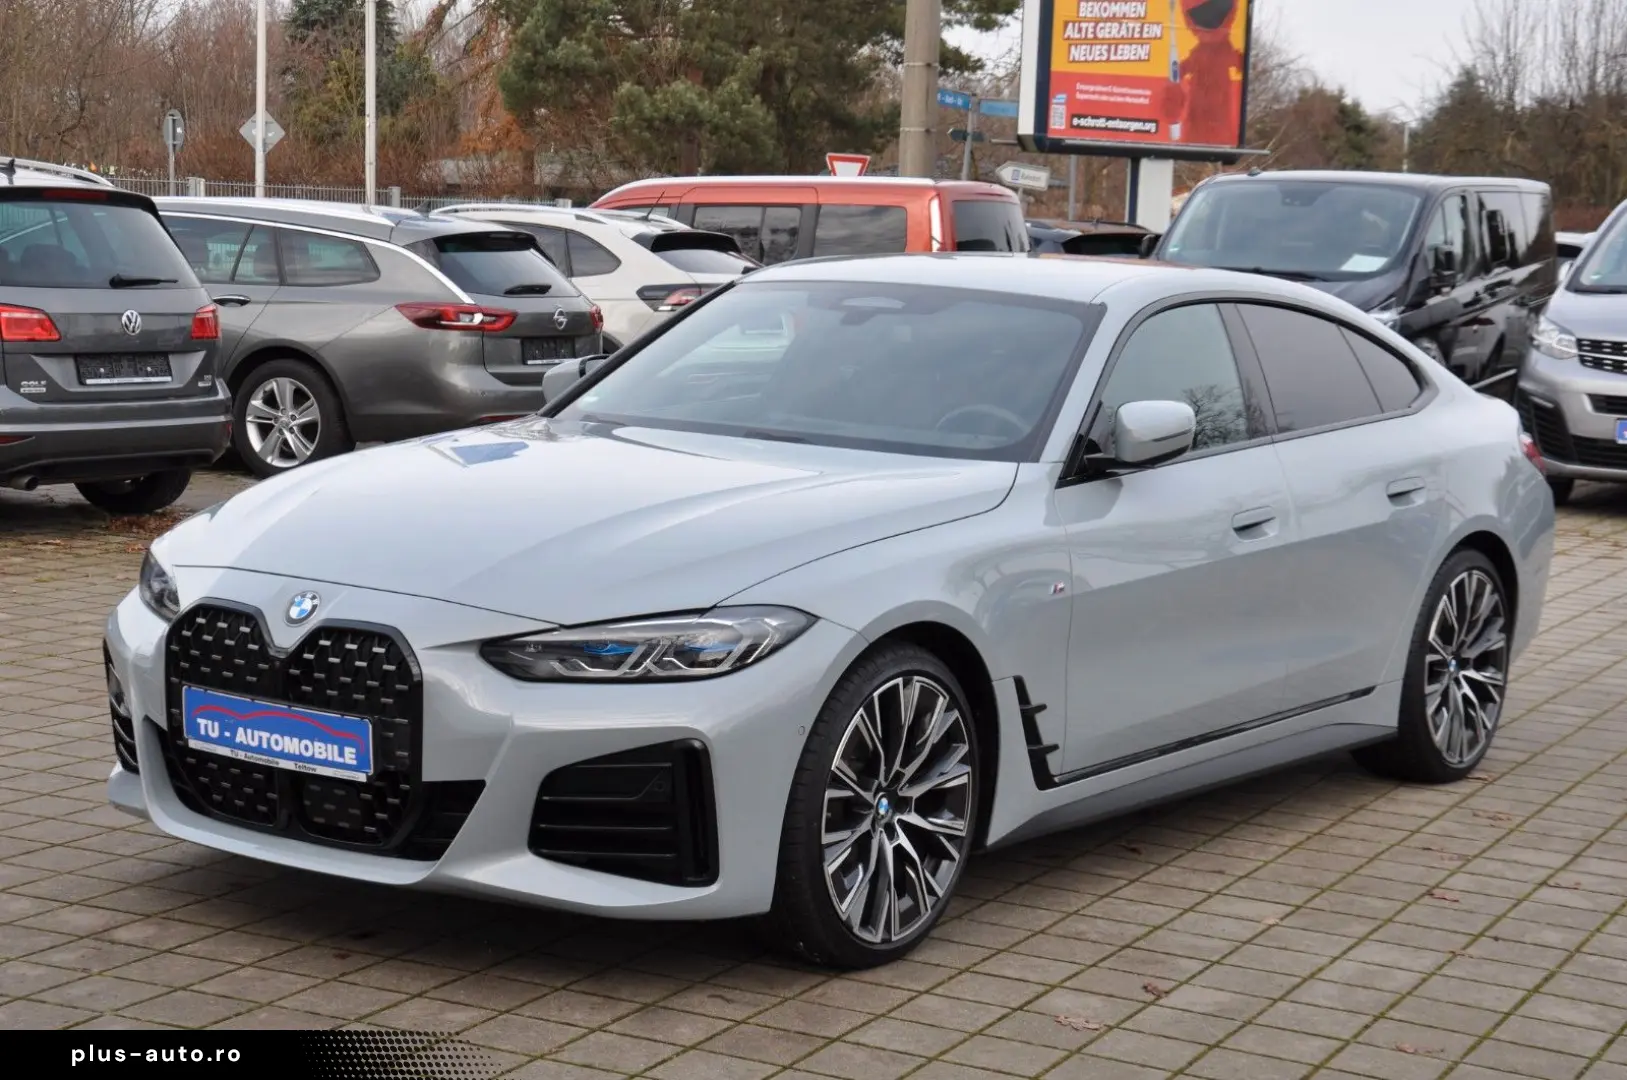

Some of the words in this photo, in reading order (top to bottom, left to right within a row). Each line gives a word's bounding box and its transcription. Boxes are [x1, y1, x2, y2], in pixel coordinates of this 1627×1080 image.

[1078, 1, 1146, 18] BEKOMMEN
[1063, 22, 1095, 39] ALTE
[1096, 20, 1141, 39] GERÄTE
[1142, 23, 1162, 38] EIN
[1069, 44, 1109, 61] NEUES
[1110, 44, 1150, 61] LEBEN!
[196, 717, 220, 738] TU
[235, 726, 358, 766] AUTOMOBILE
[244, 752, 280, 767] Automobile
[294, 762, 317, 773] Teltow
